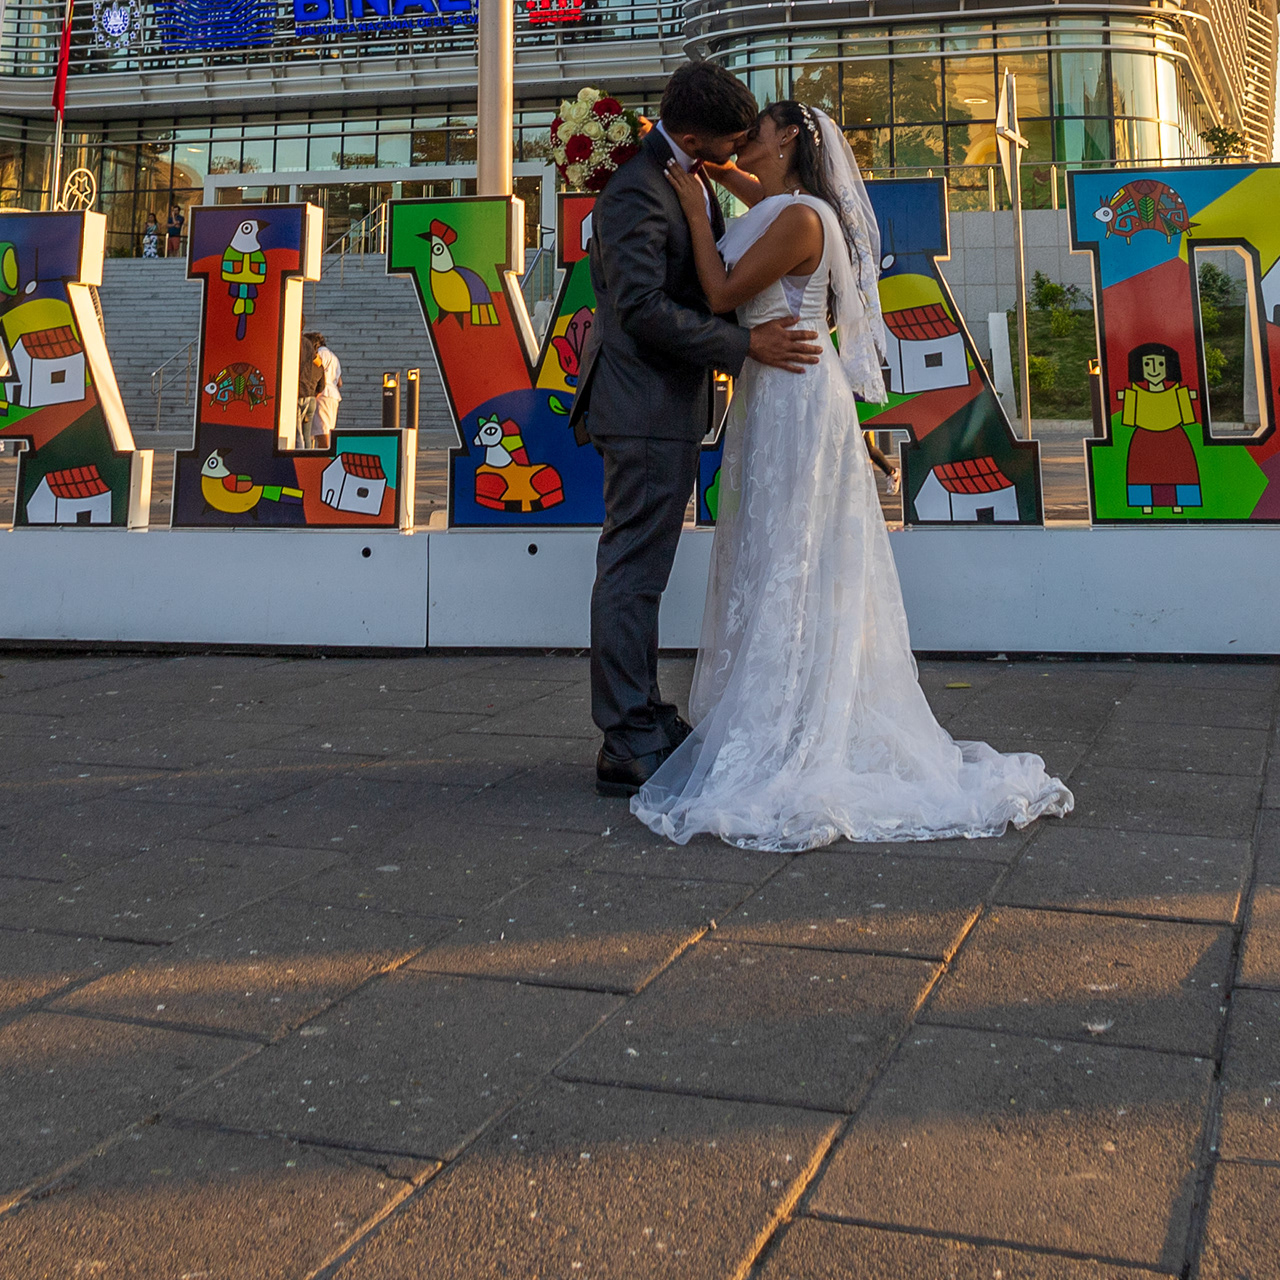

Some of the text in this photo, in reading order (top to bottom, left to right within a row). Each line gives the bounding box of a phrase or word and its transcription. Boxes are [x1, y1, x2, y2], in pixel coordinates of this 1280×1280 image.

[295, 23, 357, 36] BIBLIOTECA
[358, 19, 415, 31] NACIONAL
[416, 17, 431, 28] DE
[432, 16, 446, 26] EL
